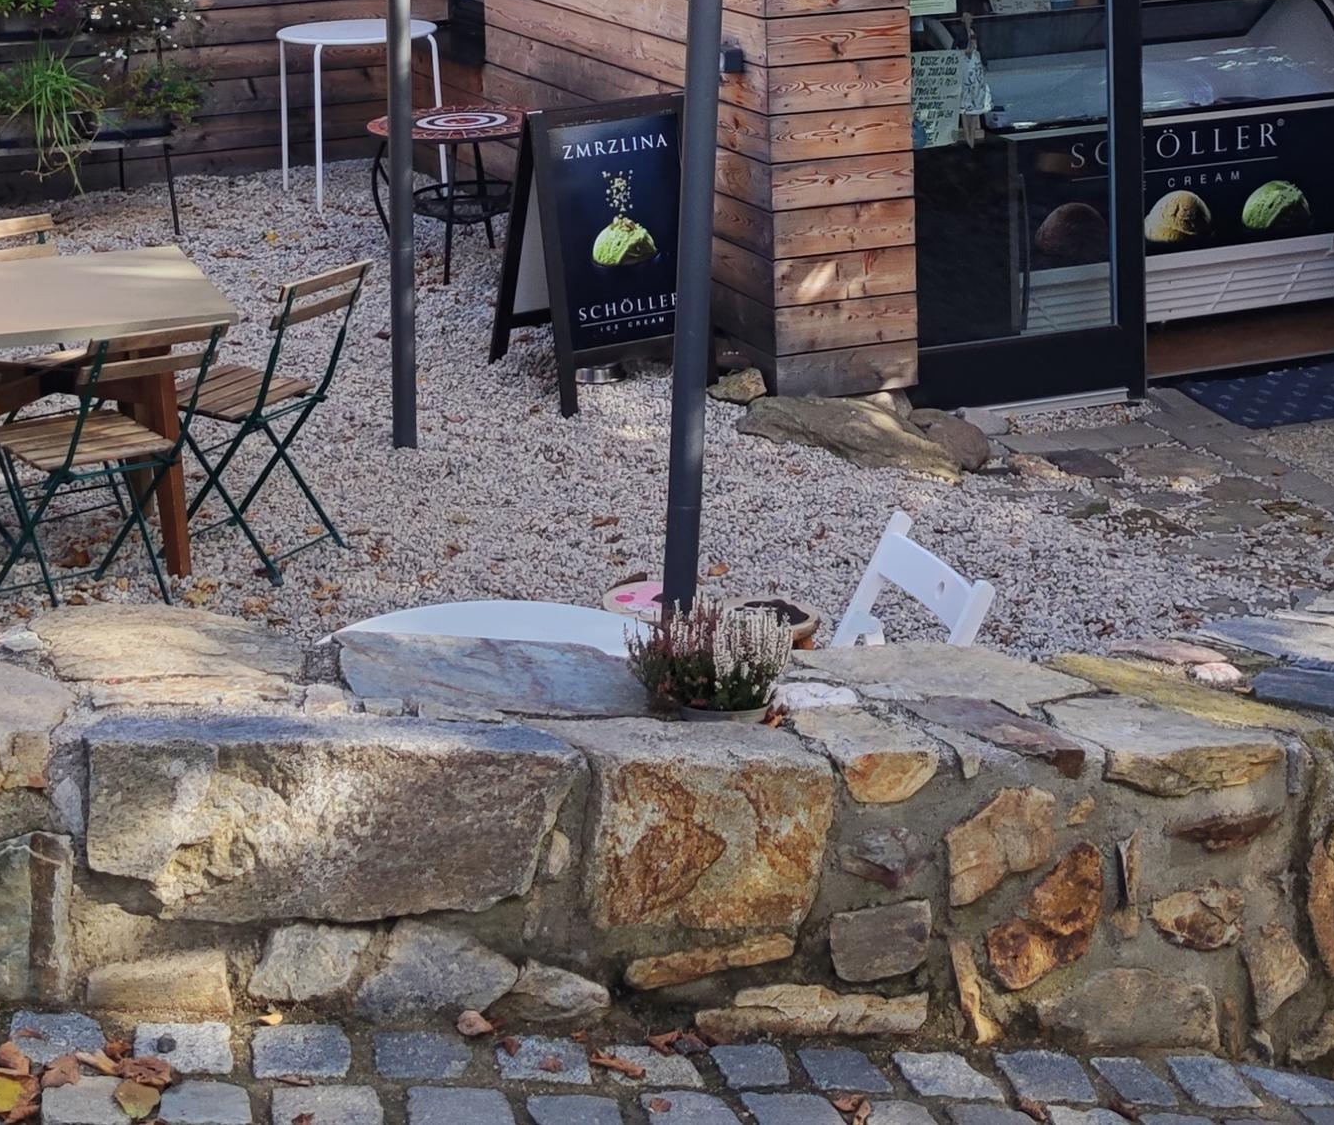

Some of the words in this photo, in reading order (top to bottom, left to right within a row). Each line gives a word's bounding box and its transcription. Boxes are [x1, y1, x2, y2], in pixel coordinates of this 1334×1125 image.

[562, 133, 668, 160] ZMRZLINA
[1070, 123, 1278, 170] SCÖLLER
[1167, 170, 1241, 189] CREAM
[600, 323, 619, 333] ICE
[627, 316, 665, 329] CREAM
